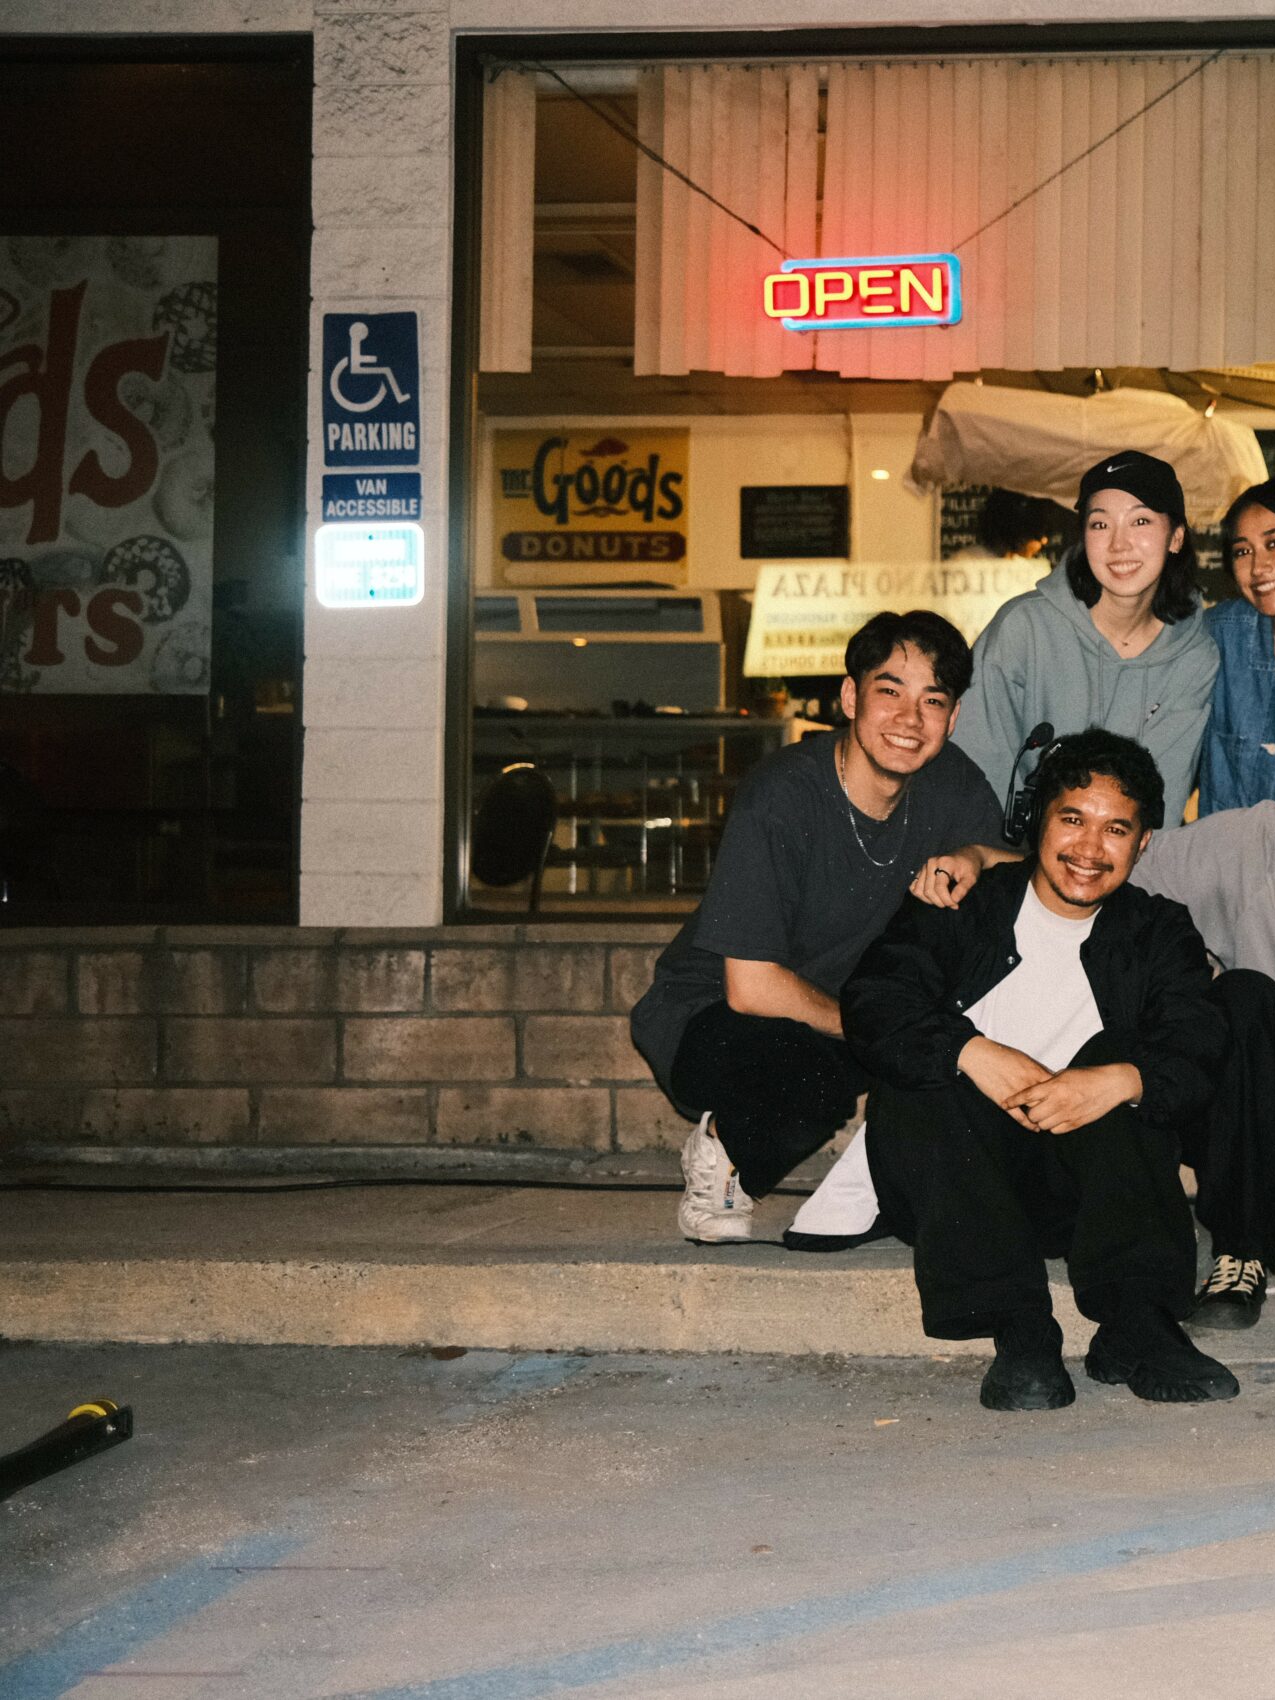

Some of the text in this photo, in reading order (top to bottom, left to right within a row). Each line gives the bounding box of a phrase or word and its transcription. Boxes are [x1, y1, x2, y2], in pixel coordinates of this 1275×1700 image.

[763, 267, 943, 318] OPEN
[0, 280, 170, 546] ds
[327, 422, 416, 451] PARKING
[356, 479, 387, 496] VAN
[533, 436, 684, 525] Goods
[326, 498, 418, 517] ACCESSIBLE
[519, 535, 671, 558] DONUTS
[0, 587, 145, 667] TS
